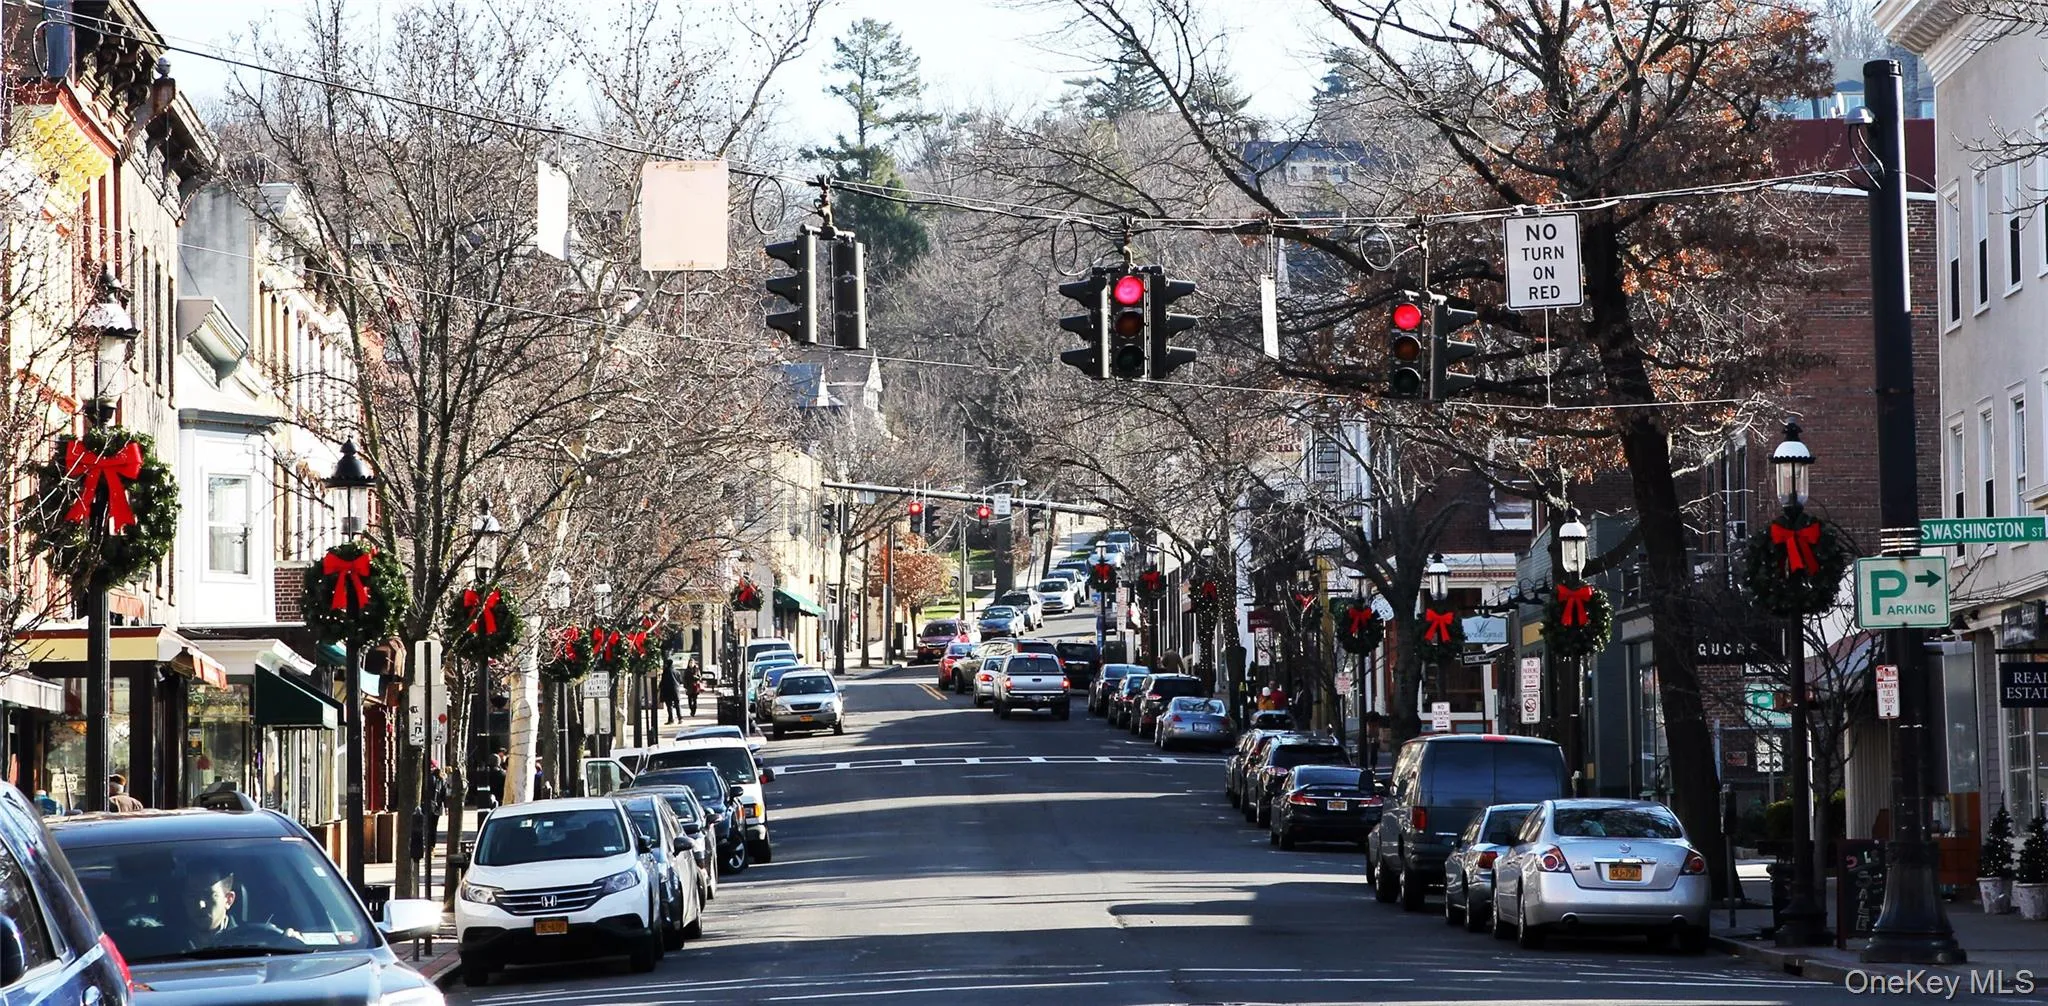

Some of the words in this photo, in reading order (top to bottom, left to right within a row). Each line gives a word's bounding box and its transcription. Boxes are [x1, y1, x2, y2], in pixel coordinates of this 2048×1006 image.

[1526, 223, 1557, 241] NO
[1521, 245, 1565, 261] TURN
[1533, 265, 1555, 280] ON
[1529, 285, 1560, 300] RED
[2031, 526, 2043, 537] ST
[1870, 569, 1936, 616] PARKING
